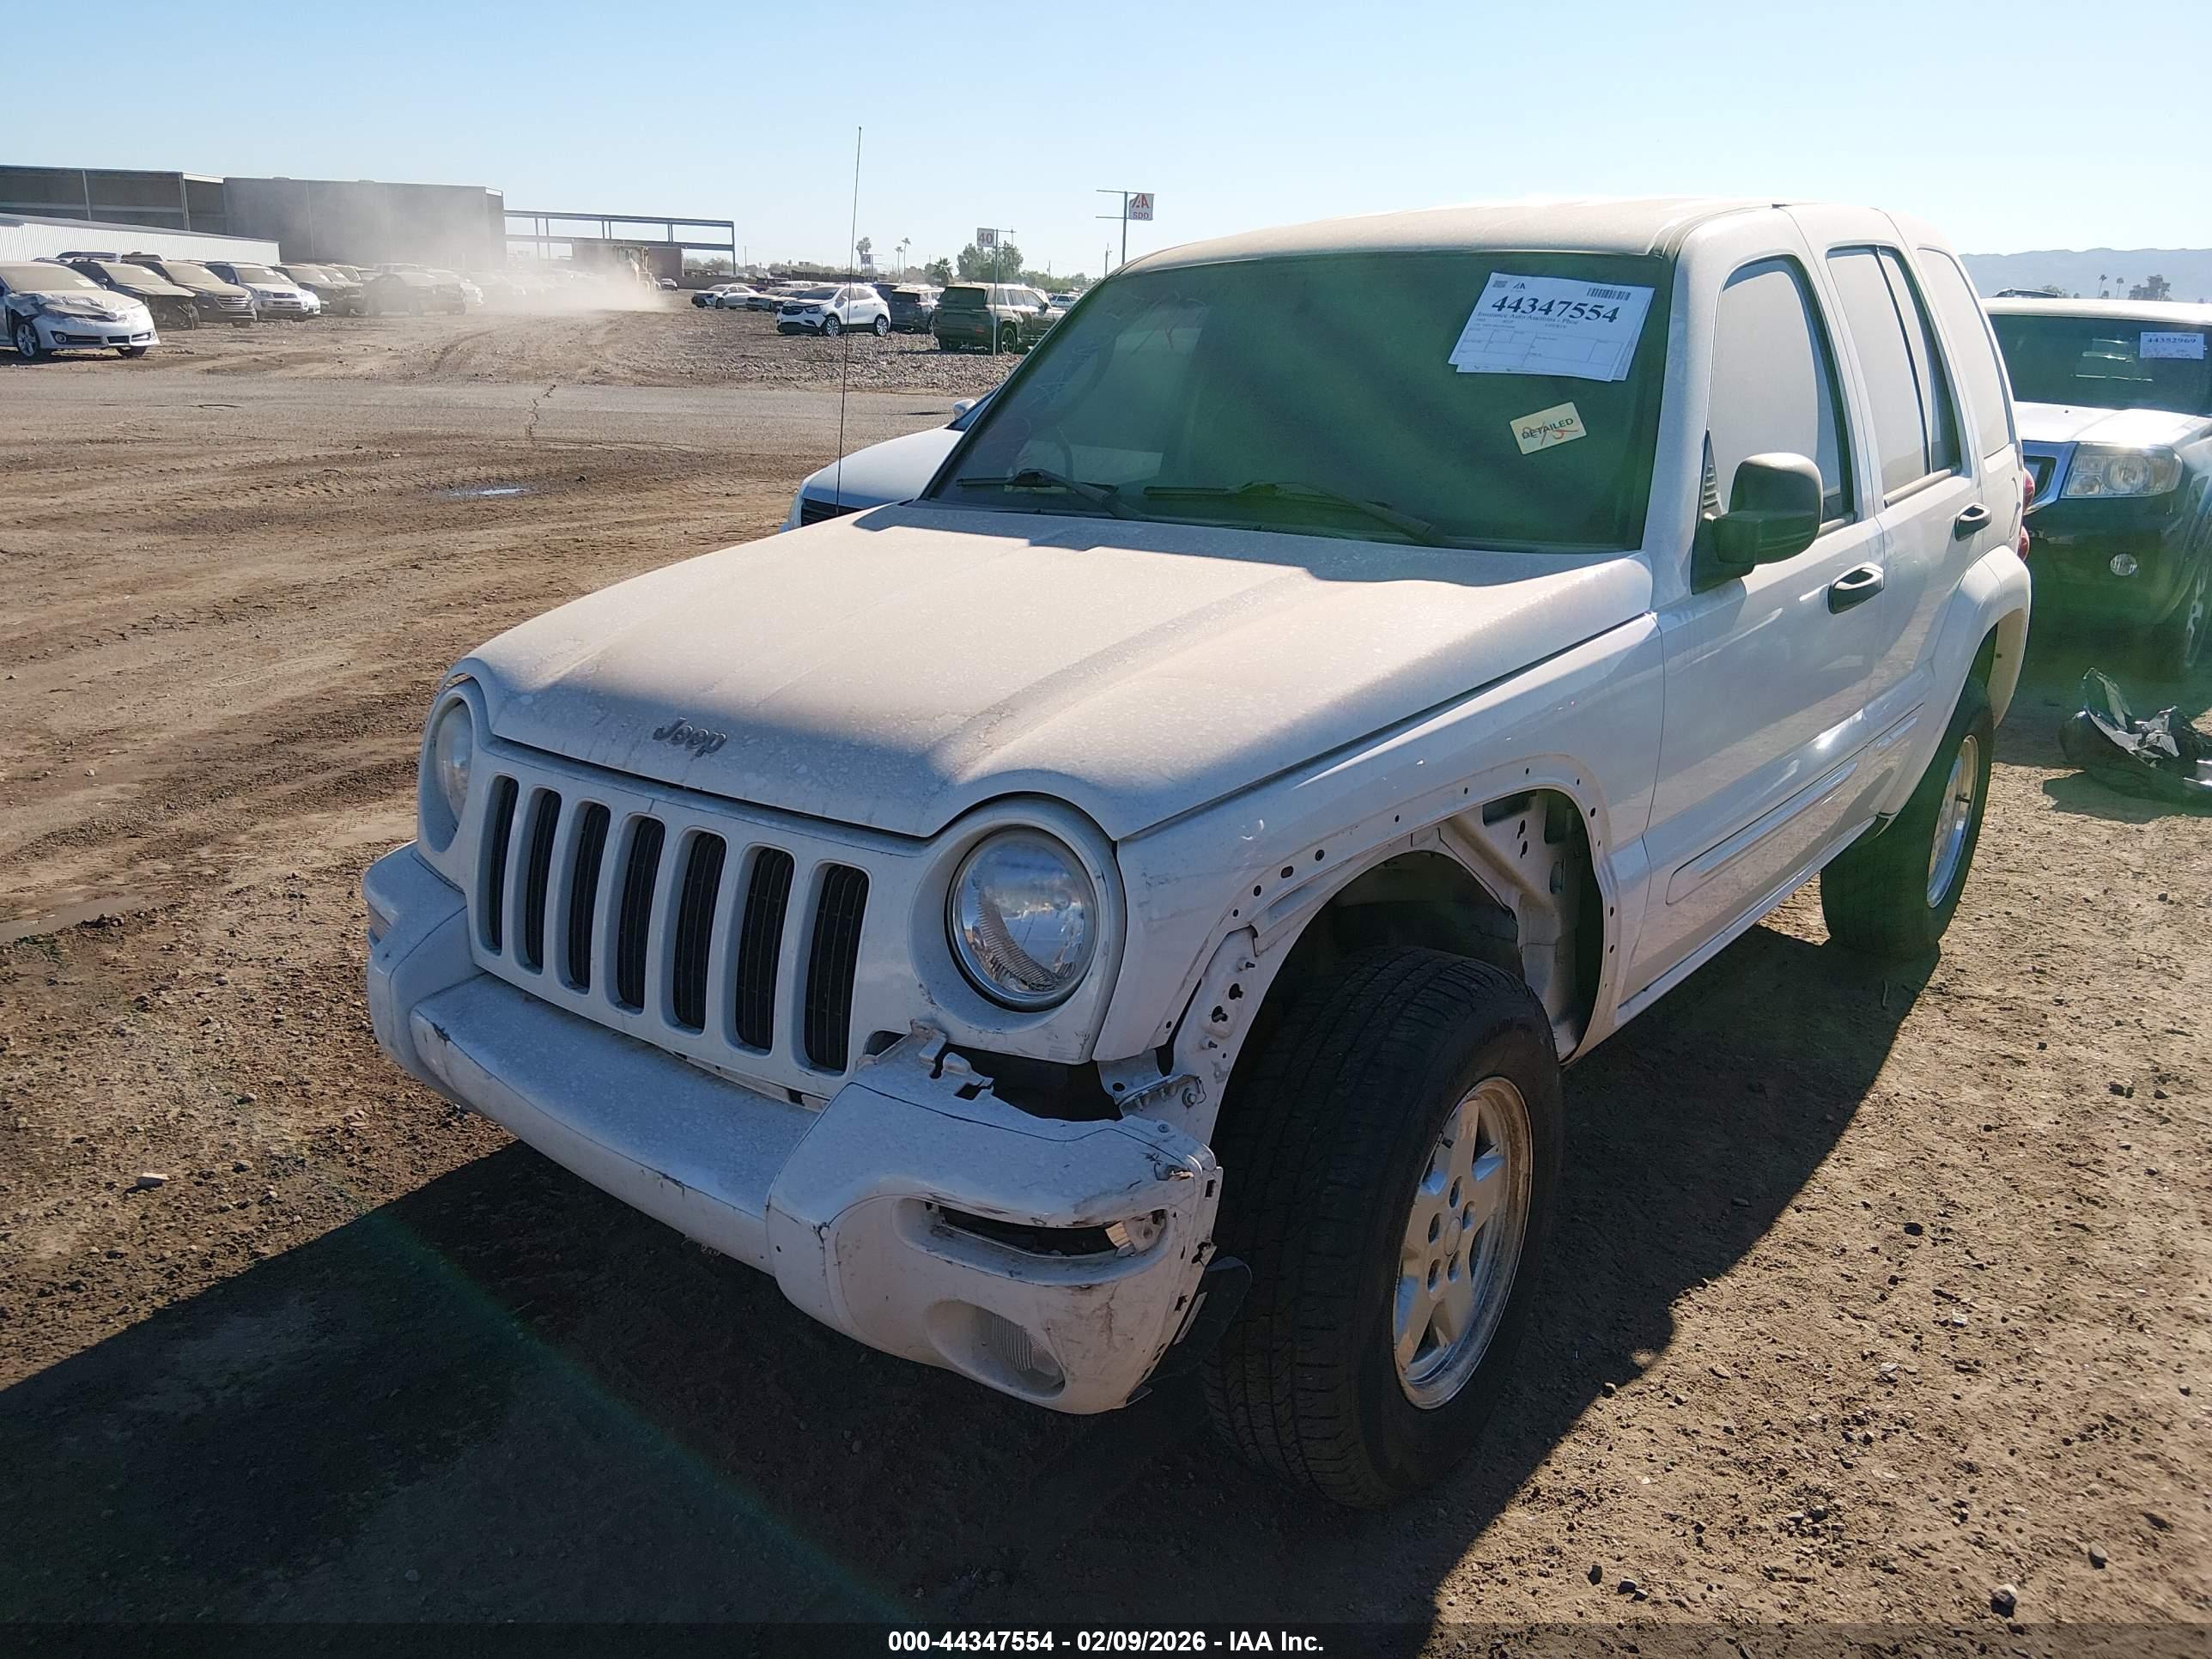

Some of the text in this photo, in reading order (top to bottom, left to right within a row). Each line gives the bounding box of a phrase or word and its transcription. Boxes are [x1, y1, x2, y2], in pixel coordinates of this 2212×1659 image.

[978, 233, 994, 245] 40
[1492, 295, 1620, 323] 44347554
[1522, 417, 1574, 440] DETAILED
[653, 716, 727, 757] Jeep
